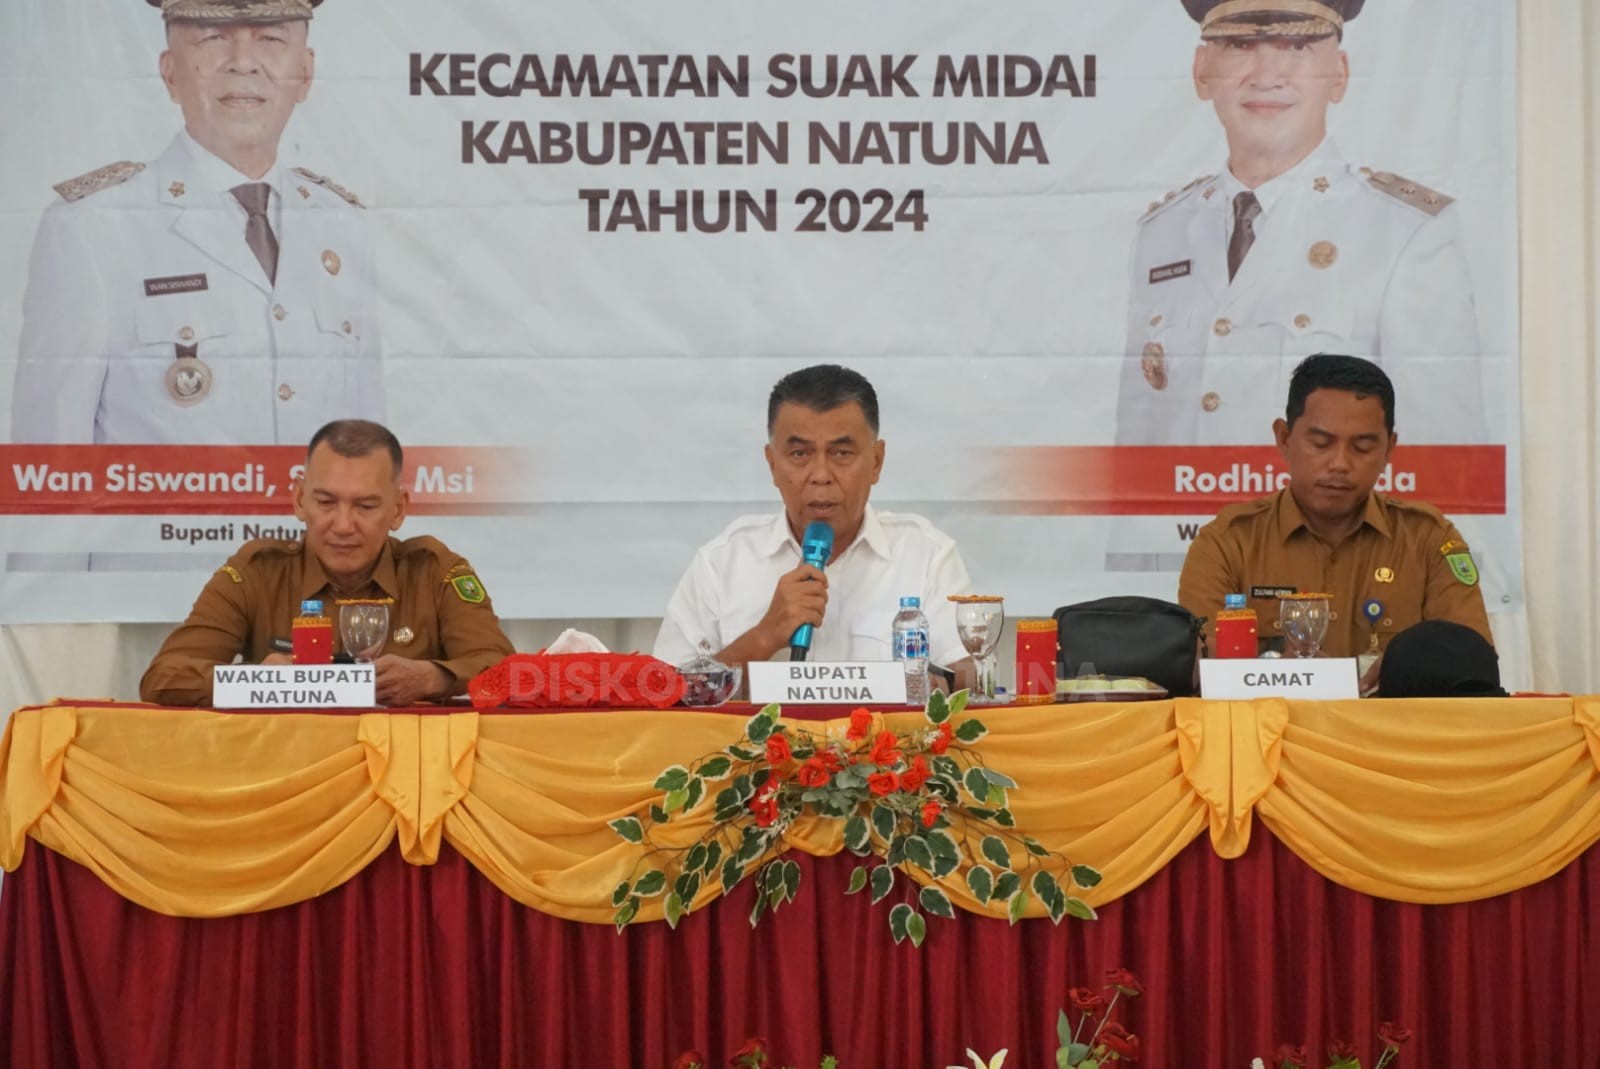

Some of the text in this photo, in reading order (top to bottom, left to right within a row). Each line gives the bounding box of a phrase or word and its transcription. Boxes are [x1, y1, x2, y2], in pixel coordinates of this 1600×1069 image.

[409, 53, 1096, 98] KECAMATAN SUAK MIDAI
[461, 120, 1050, 165] KABUPATEN NATUNA
[579, 188, 929, 232] TAHUN 2024
[12, 464, 93, 492] Wan
[105, 464, 276, 497] Siswandi,
[414, 465, 473, 494] Msi
[160, 523, 234, 545] Bupati
[216, 670, 372, 684] WAKIL BUPATI
[790, 666, 867, 680] BUPATI
[1243, 672, 1315, 687] CAMAT
[250, 690, 337, 704] NATUNA
[787, 686, 873, 700] NATUNA
